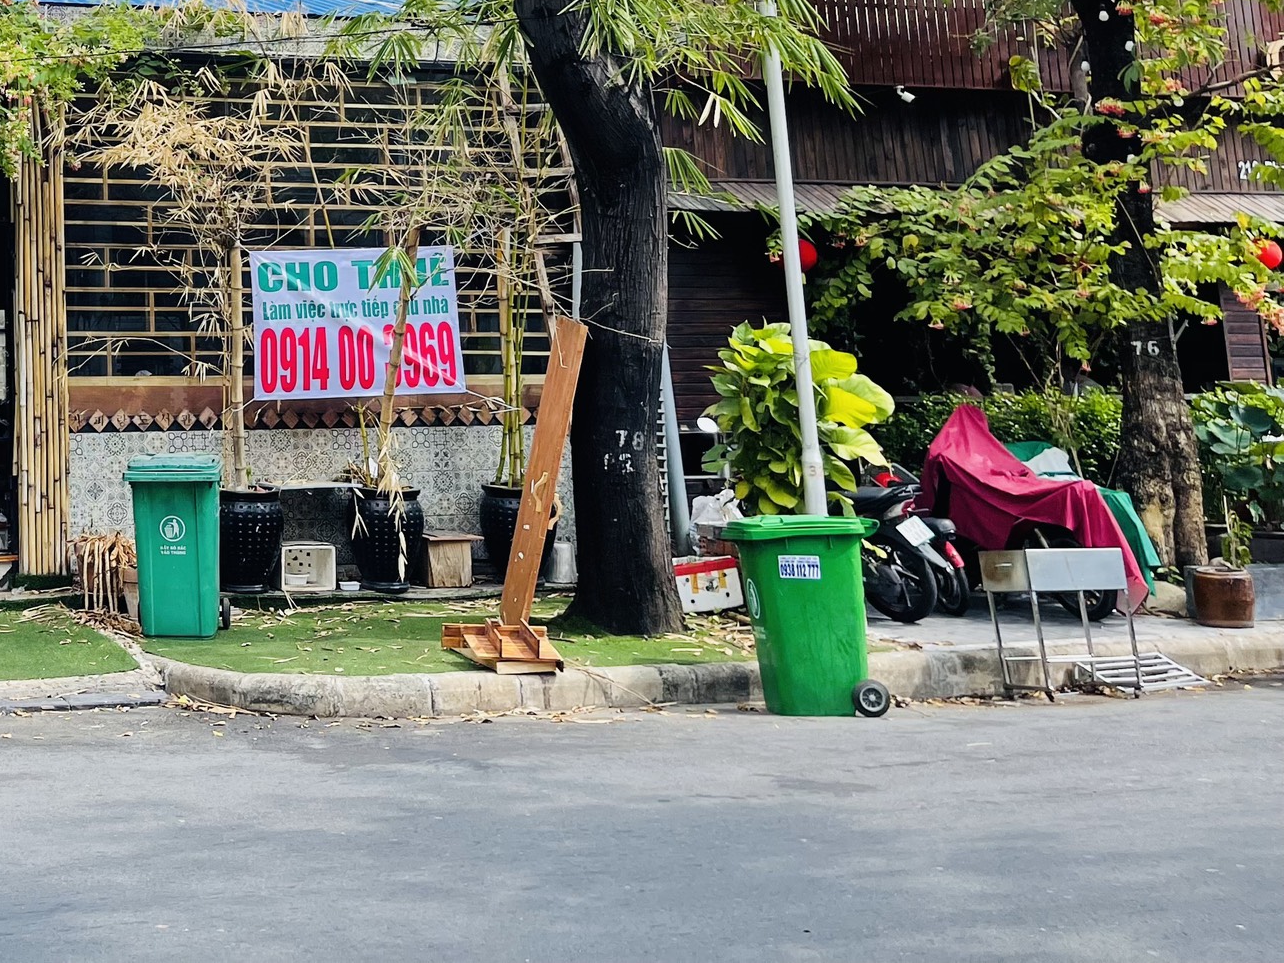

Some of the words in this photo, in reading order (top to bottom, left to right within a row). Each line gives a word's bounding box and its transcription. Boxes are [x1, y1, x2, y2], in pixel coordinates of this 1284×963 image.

[257, 260, 338, 292] CHO
[262, 301, 292, 321] Làm
[296, 299, 326, 322] việc
[331, 298, 357, 322] trực
[361, 295, 389, 318] tiếp
[423, 295, 449, 315] nhà
[260, 326, 330, 394] 0914
[337, 325, 375, 391] 00
[807, 564, 819, 578] 777
